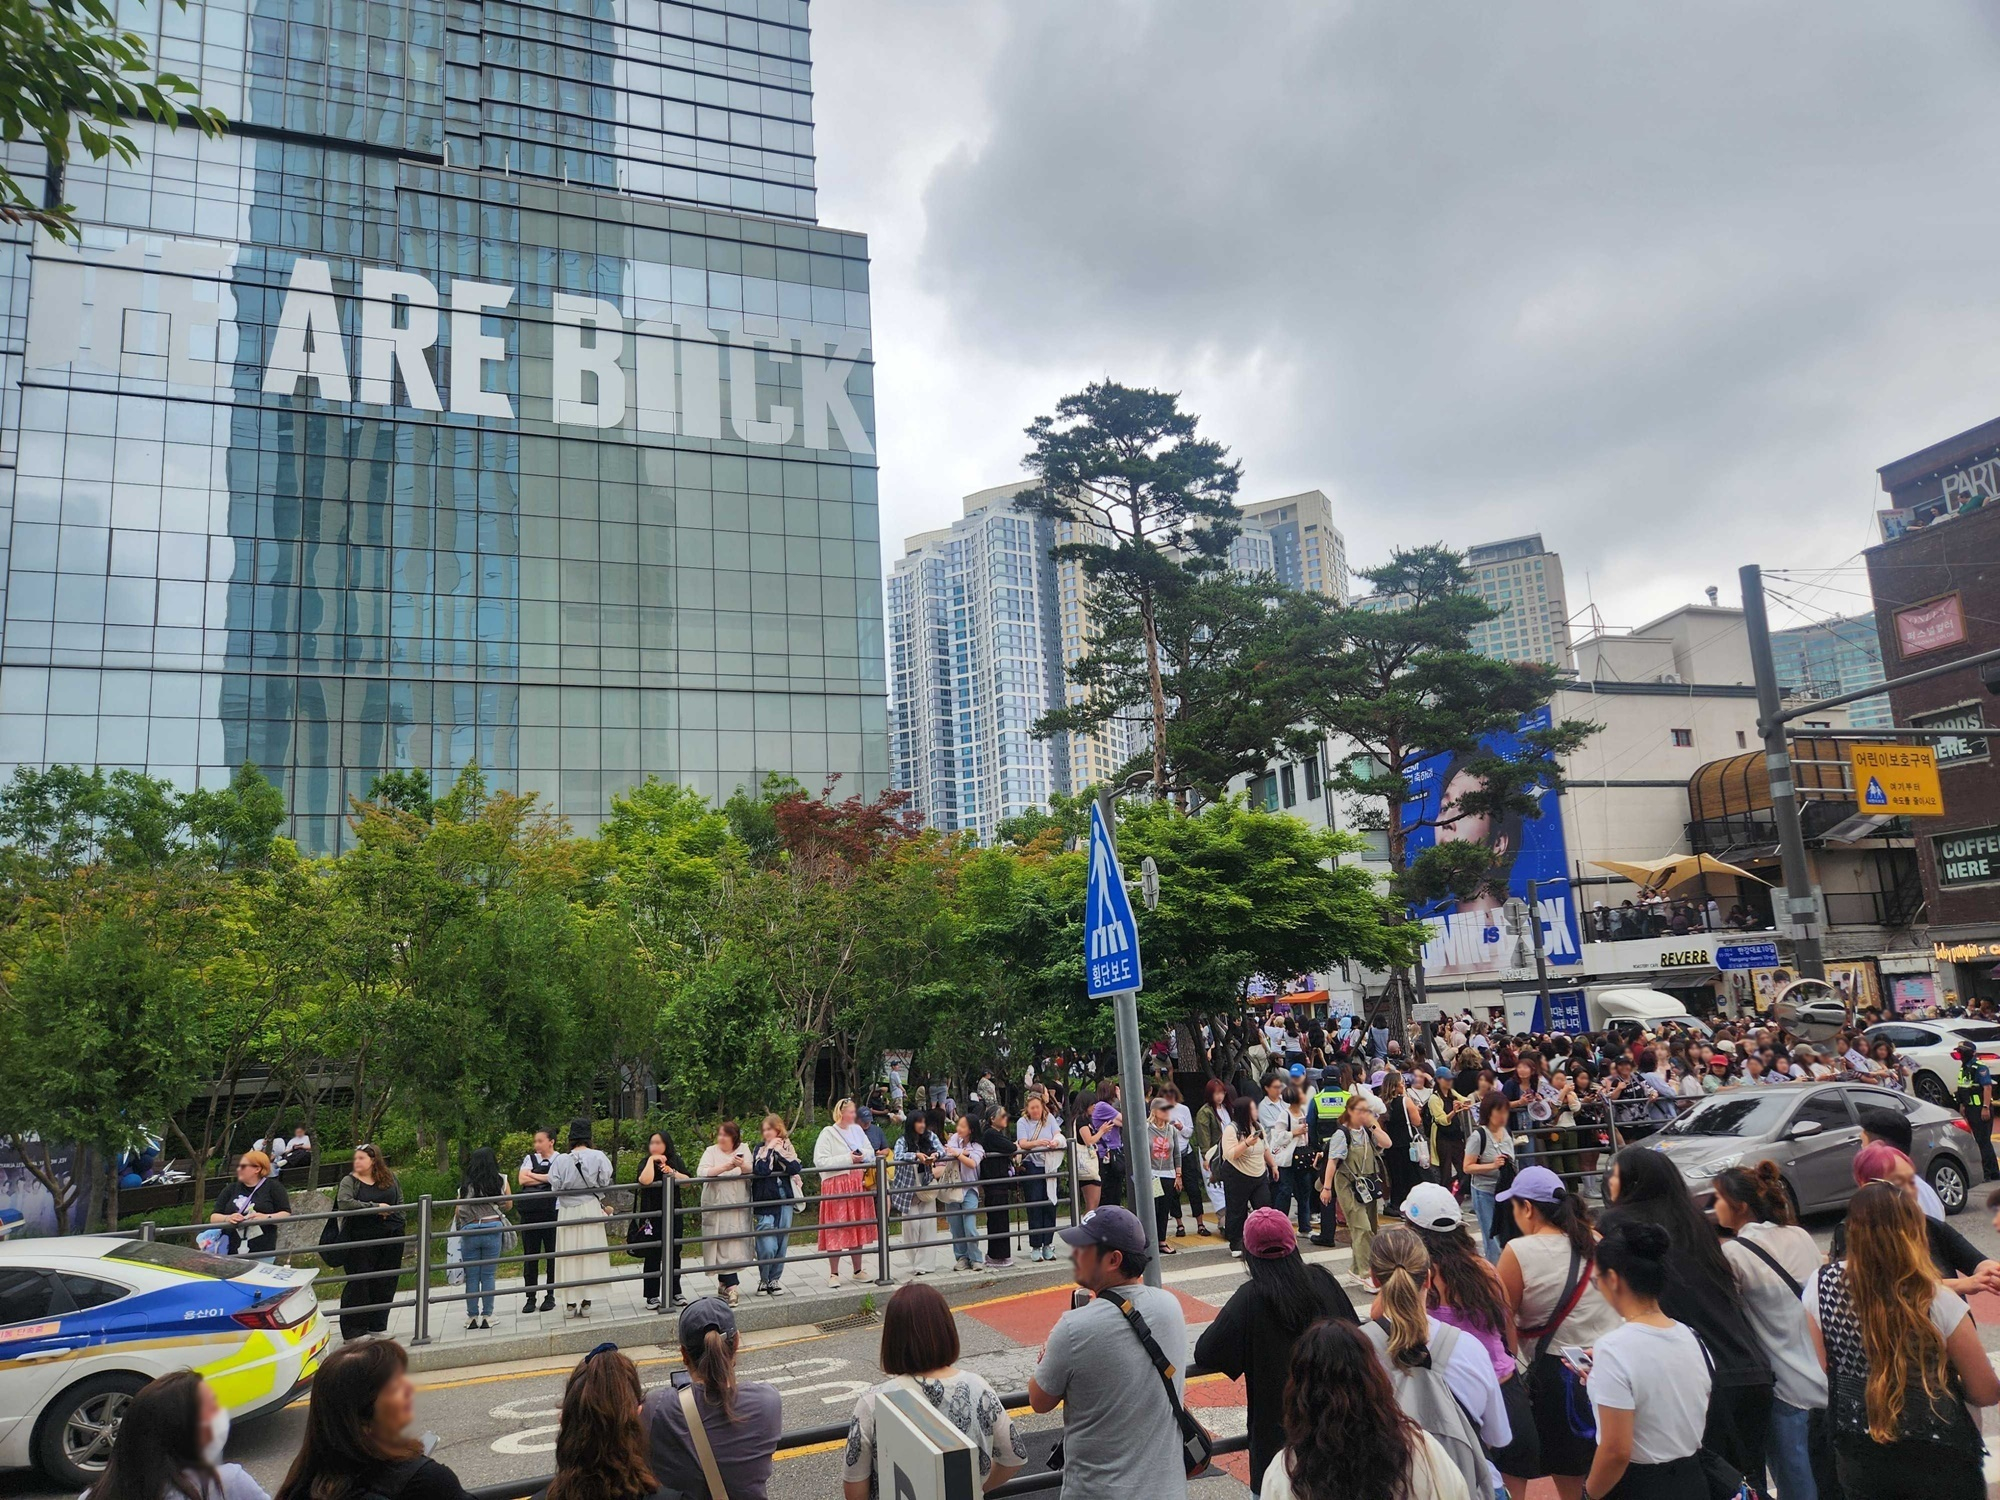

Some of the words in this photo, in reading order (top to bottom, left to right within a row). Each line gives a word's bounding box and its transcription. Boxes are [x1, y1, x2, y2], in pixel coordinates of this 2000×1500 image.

[261, 258, 516, 420] ARE
[1942, 457, 2000, 514] PART
[1856, 752, 1932, 769] 어린이보호구역
[1889, 782, 1921, 791] 여기부터
[1892, 796, 1910, 805] 속도를
[1912, 796, 1937, 805] 줄이시오
[1946, 859, 1991, 879] HERE
[1483, 926, 1500, 944] IS
[1660, 950, 1709, 967] REVERB
[1092, 958, 1132, 988] 횡단보도
[183, 1308, 225, 1320] 용산01
